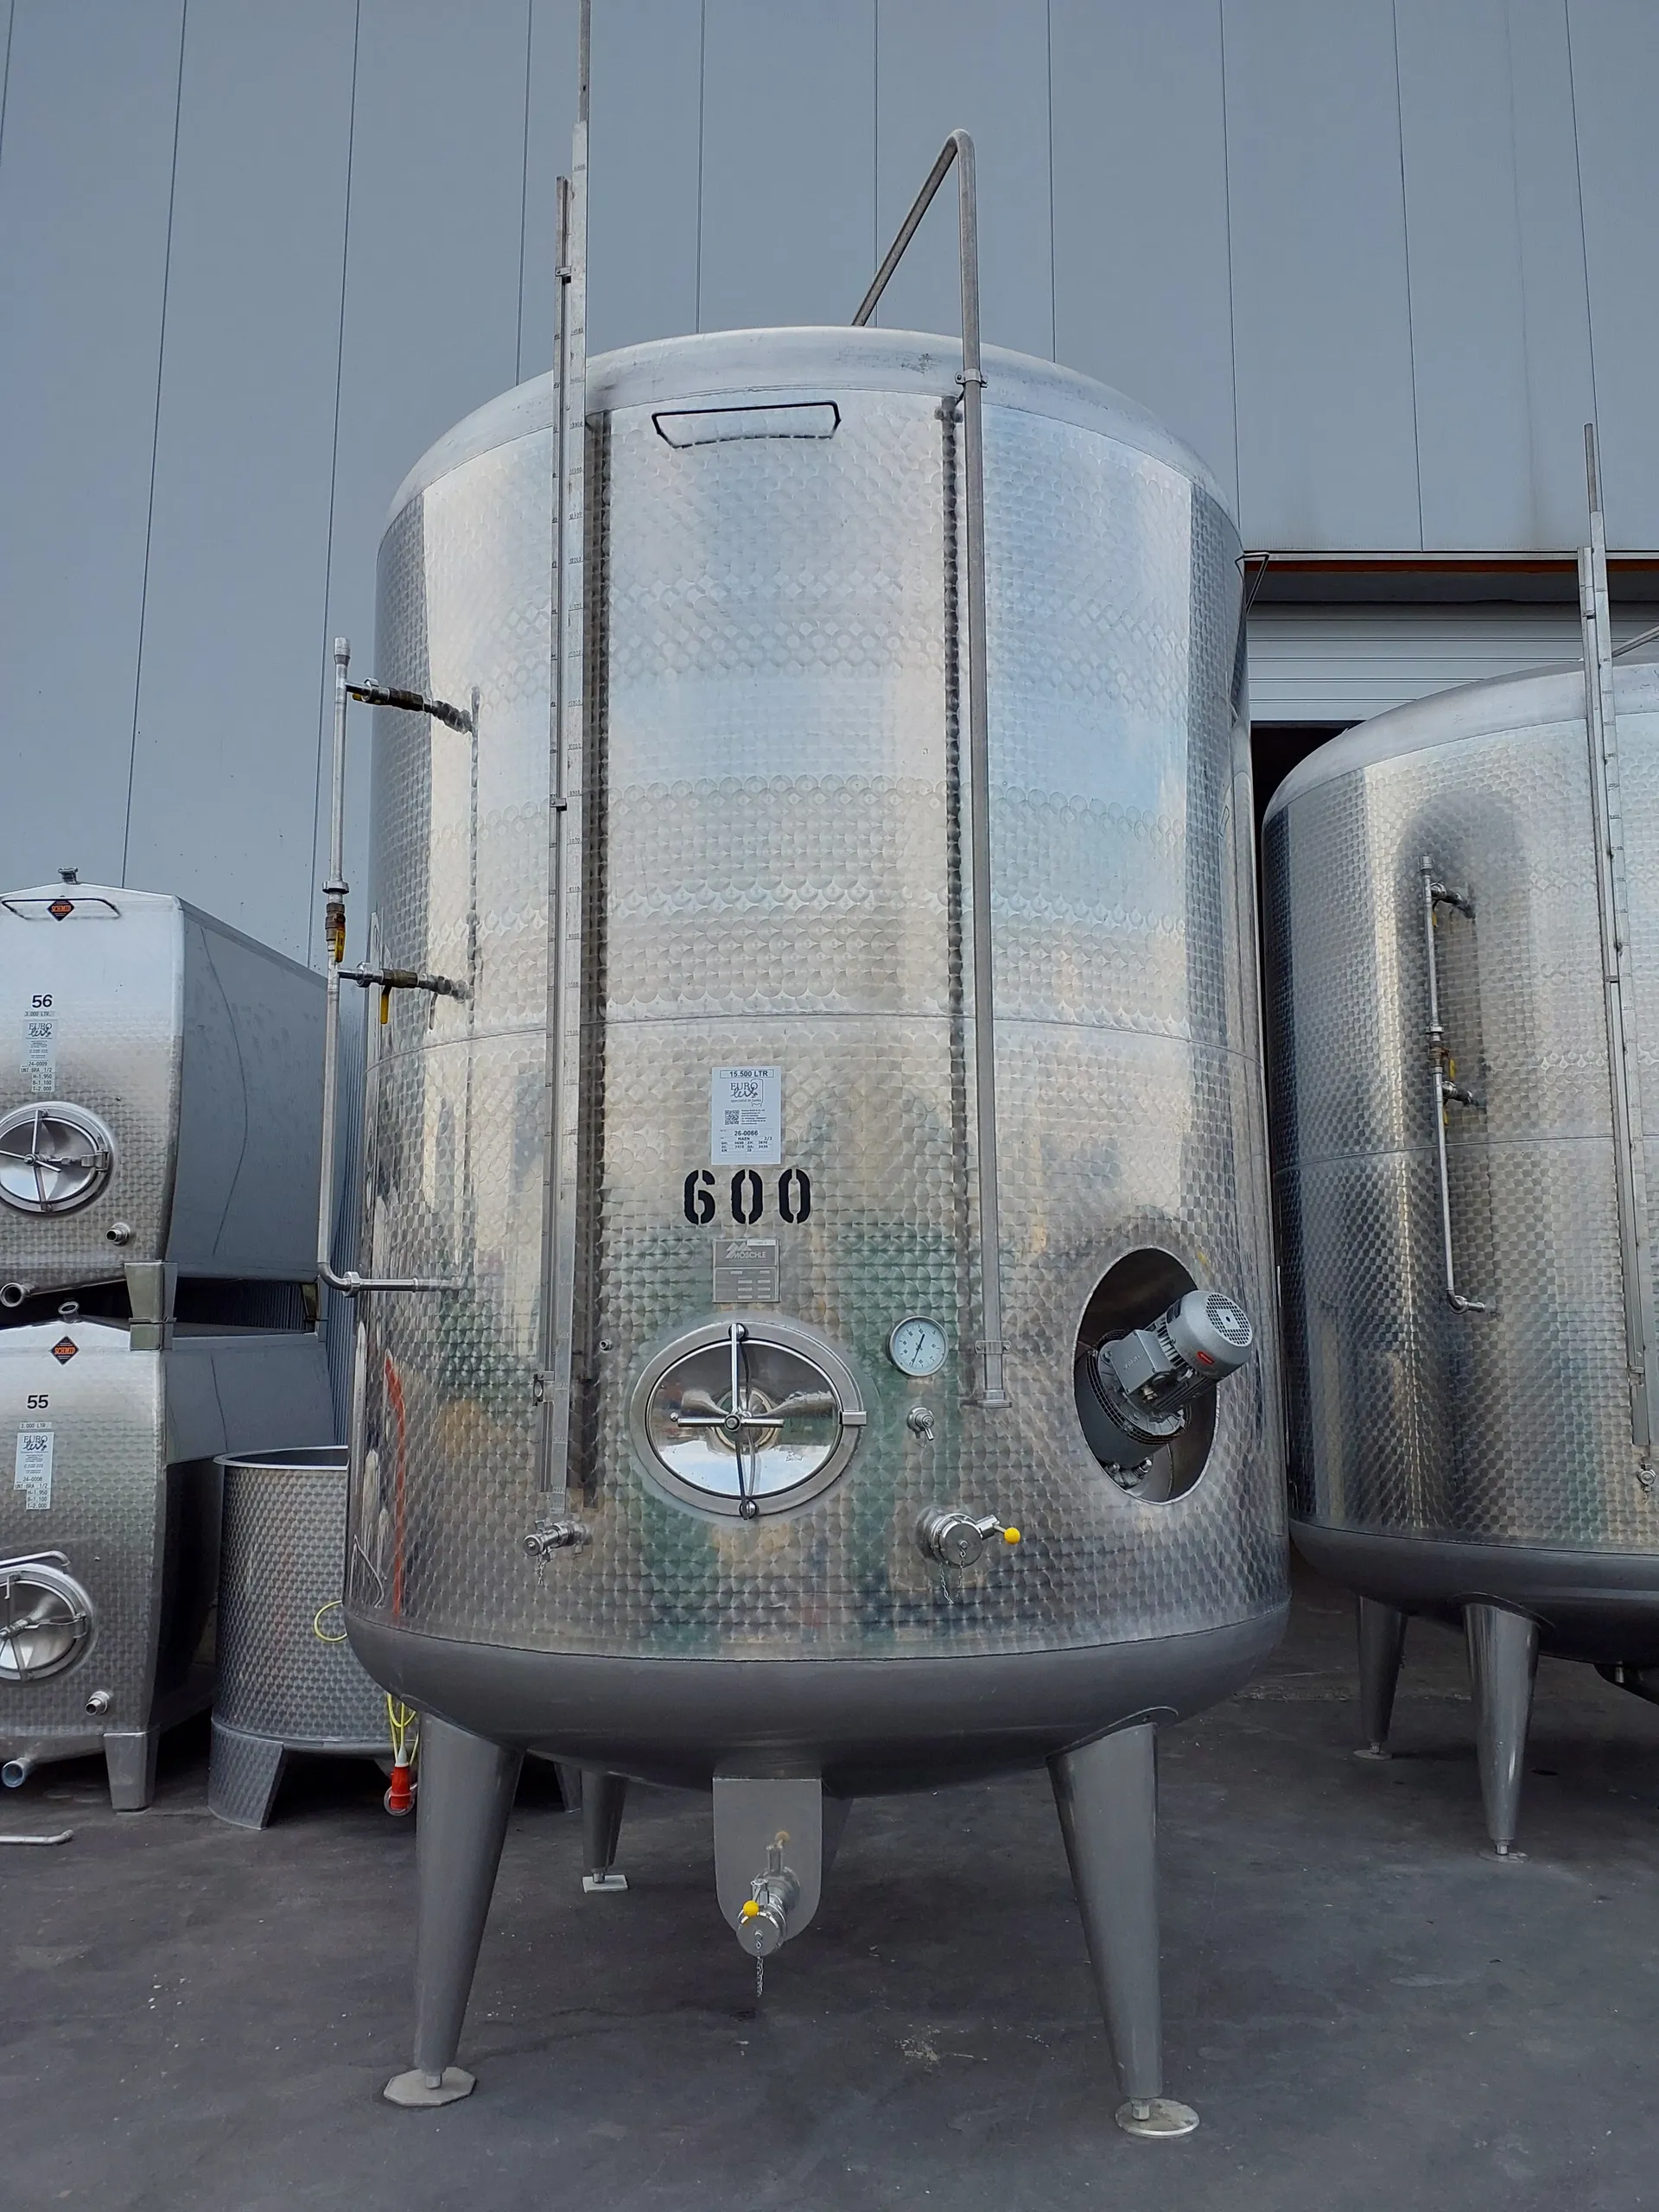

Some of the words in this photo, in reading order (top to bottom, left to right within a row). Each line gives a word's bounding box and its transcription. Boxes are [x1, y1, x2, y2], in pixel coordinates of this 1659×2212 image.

[32, 994, 54, 1008] 56
[730, 1082, 759, 1090] EURO
[684, 1168, 811, 1225] 600
[27, 1394, 49, 1409] 55
